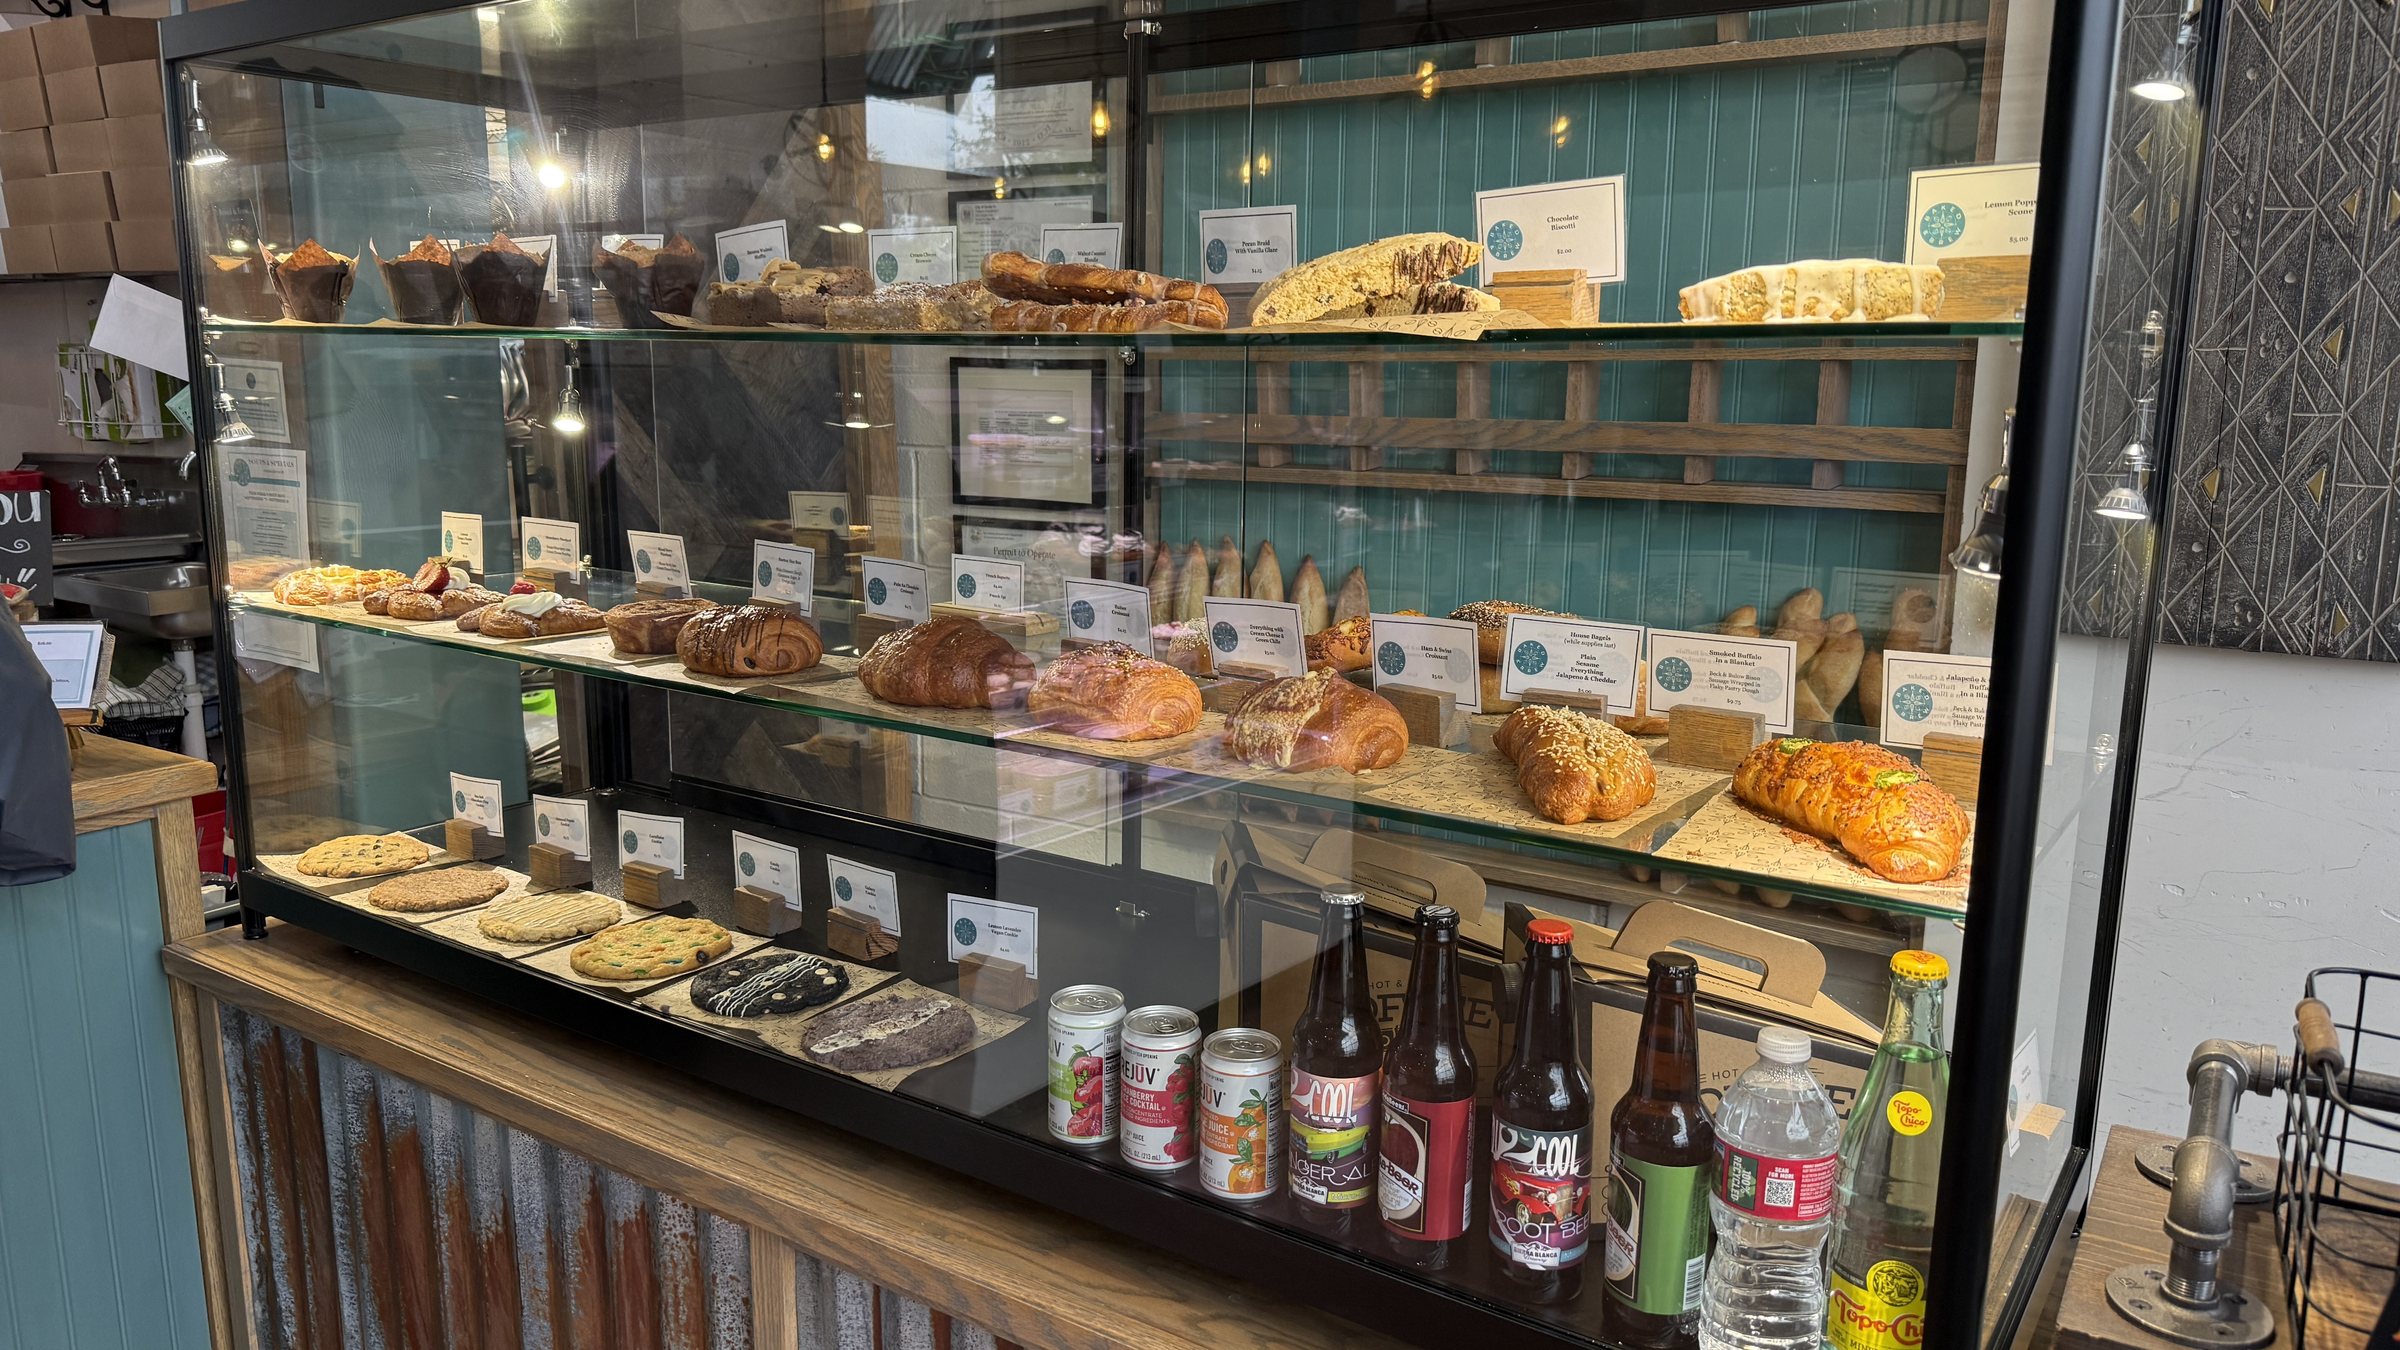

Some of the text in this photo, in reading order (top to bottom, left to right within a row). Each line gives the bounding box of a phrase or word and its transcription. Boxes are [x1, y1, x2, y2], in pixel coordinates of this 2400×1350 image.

[1984, 201, 2013, 209] Lemon
[2007, 208, 2034, 217] Scone
[1546, 214, 1580, 223] Chocolate
[1550, 222, 1576, 231] Biscotti
[993, 546, 1056, 560] Permit to Operate
[1249, 624, 1274, 632] Everything
[1570, 631, 1590, 639] House
[1603, 642, 1616, 650] last)
[1424, 652, 1449, 661] Croissant
[1580, 653, 1597, 661] Plain
[1709, 649, 1762, 660] Smoked Buffalo
[1575, 660, 1600, 668] Sesame
[1729, 658, 1755, 667] Blanket
[1570, 666, 1604, 677] Everything
[1590, 675, 1617, 684] Cheddar
[1708, 677, 1729, 685] Sausage
[1730, 678, 1754, 688] Wrapped
[1709, 683, 1760, 695] Flaky Pastry Dough
[1960, 690, 1967, 698] In
[1951, 712, 1975, 720] Sausage
[1952, 719, 1968, 728] Flaky
[1004, 930, 1019, 938] Cookie
[1396, 980, 1403, 988] &
[1712, 1068, 1739, 1081] HOT
[1122, 1085, 1155, 1102] ANBERRY
[1129, 1097, 1161, 1111] COCKTAIL
[1304, 1079, 1357, 1123] COOL
[1893, 1100, 1922, 1115] Topo
[1900, 1113, 1928, 1128] Chico
[1208, 1123, 1229, 1136] JUICE
[1132, 1132, 1145, 1142] JUICE
[1151, 1153, 1161, 1161] mL)
[1529, 1133, 1580, 1178] COOL
[1290, 1151, 1347, 1186] NGER
[1774, 1166, 1790, 1174] SCAN
[1731, 1155, 1742, 1202] RECYCLED
[1768, 1171, 1795, 1180] FOR MORE
[1741, 1168, 1752, 1195] 100%
[1305, 1186, 1325, 1196] BLANCA
[1496, 1209, 1556, 1245] ROOT
[1534, 1250, 1558, 1259] BLANCA
[1834, 1289, 1888, 1333] Topo
